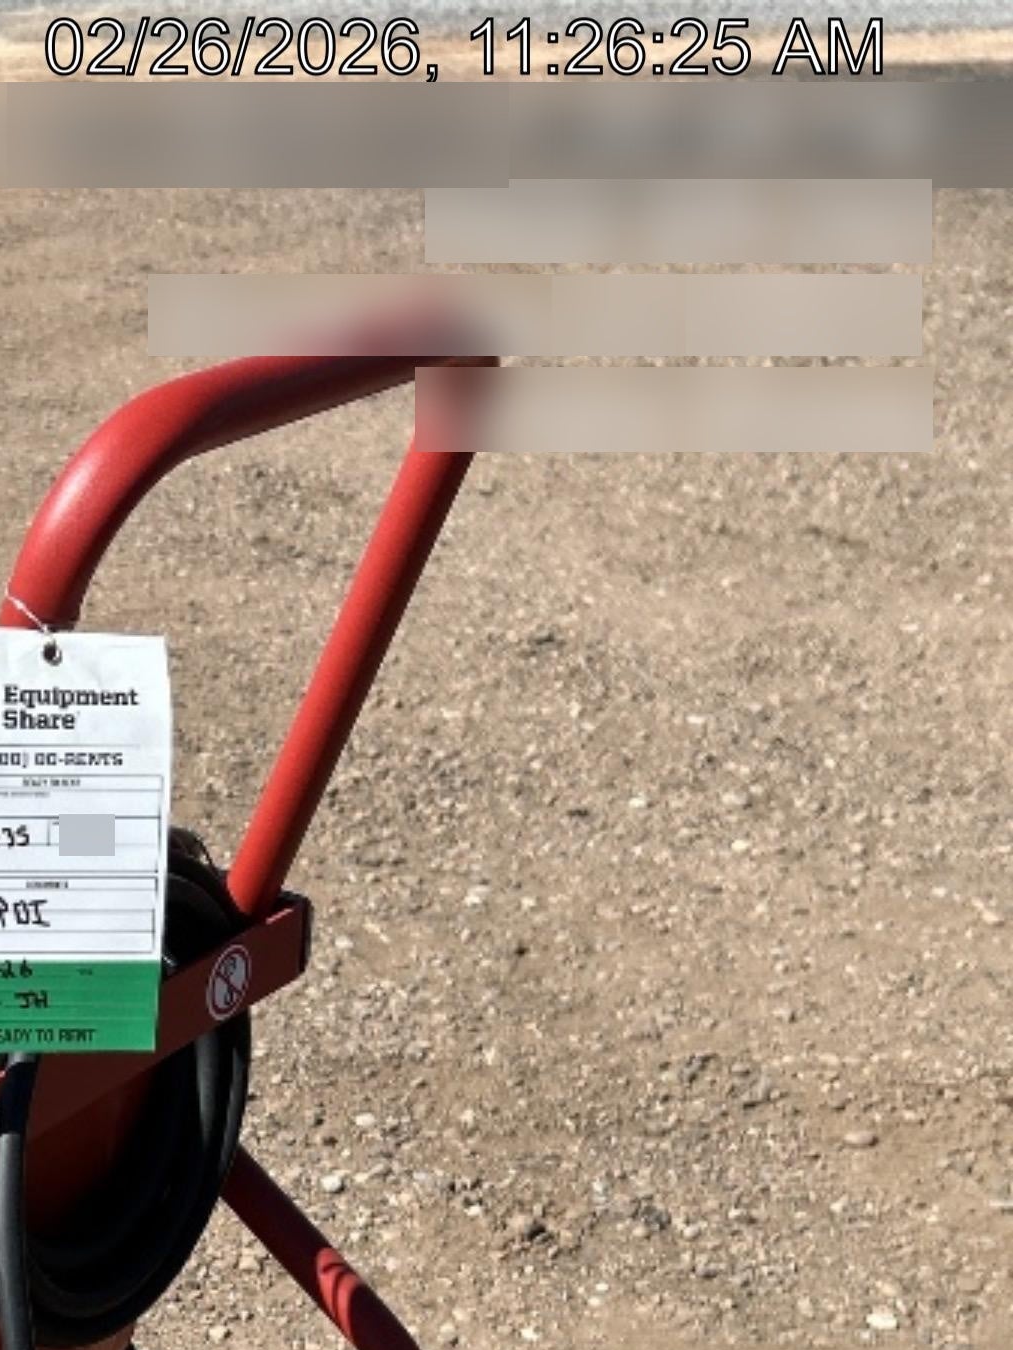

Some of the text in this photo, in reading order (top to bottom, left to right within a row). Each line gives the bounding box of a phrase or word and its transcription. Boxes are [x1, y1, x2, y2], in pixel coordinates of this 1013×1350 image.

[3, 684, 140, 709] Equipment
[2, 709, 76, 730] Share
[35, 1028, 55, 1042] TO
[58, 1028, 98, 1042] RENT
